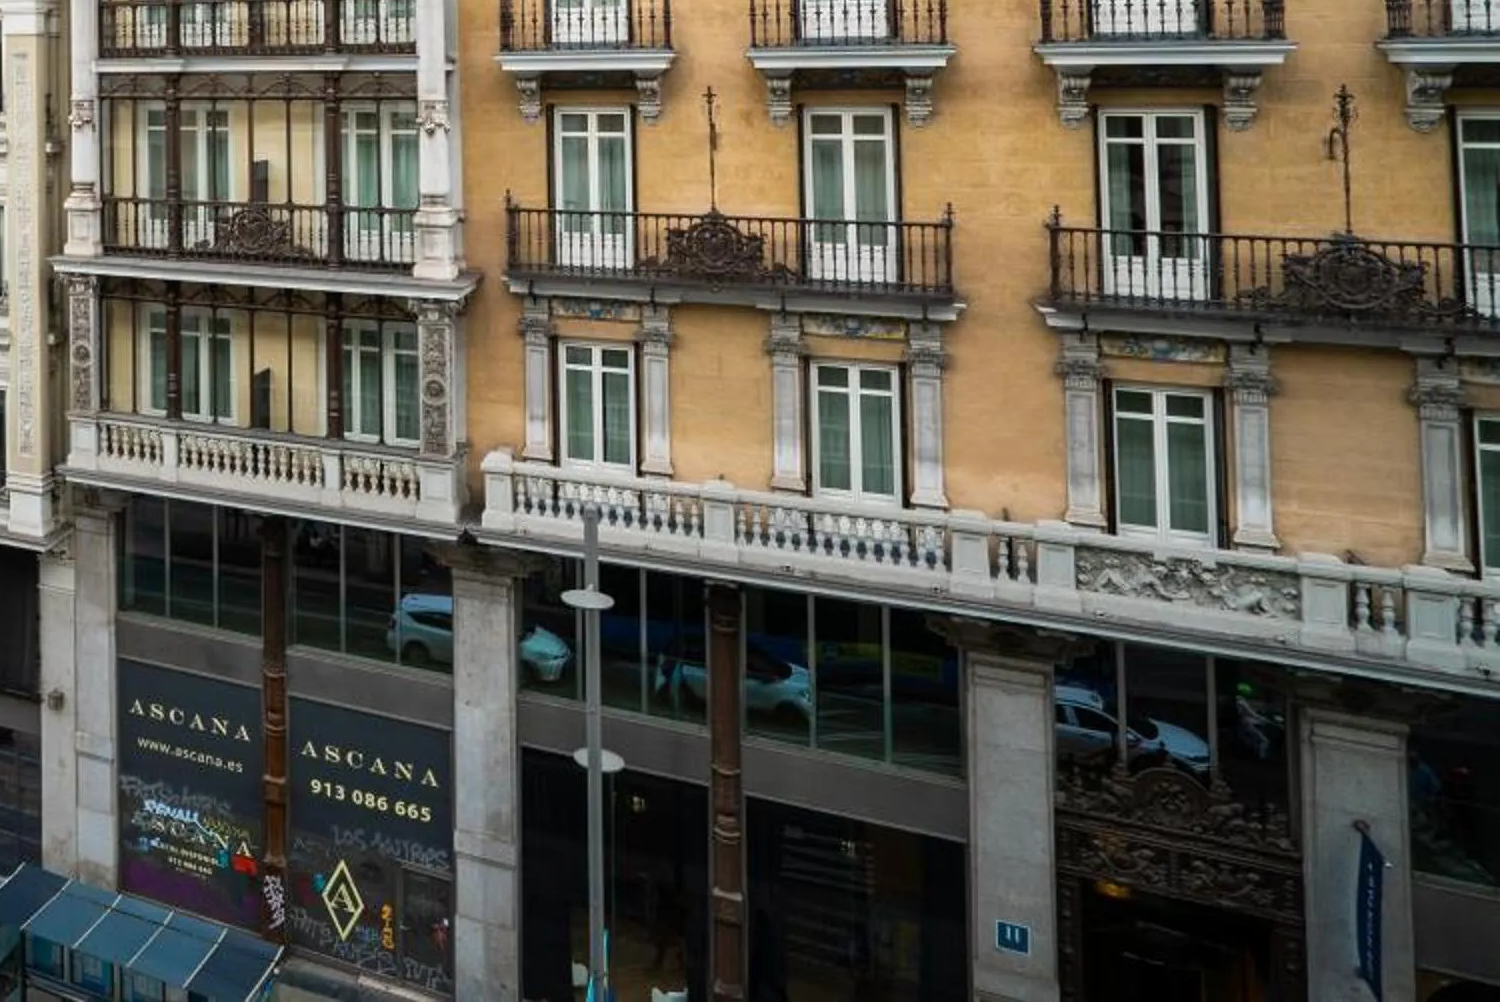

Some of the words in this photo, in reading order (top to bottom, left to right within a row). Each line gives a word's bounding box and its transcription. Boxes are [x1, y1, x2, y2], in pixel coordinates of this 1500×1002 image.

[129, 699, 251, 742] ASCANA
[137, 737, 244, 773] www.ascana.es
[301, 741, 439, 787] ASCANA
[311, 779, 346, 801] 913
[352, 789, 388, 811] 086
[395, 801, 432, 822] 665
[330, 883, 357, 913] A
